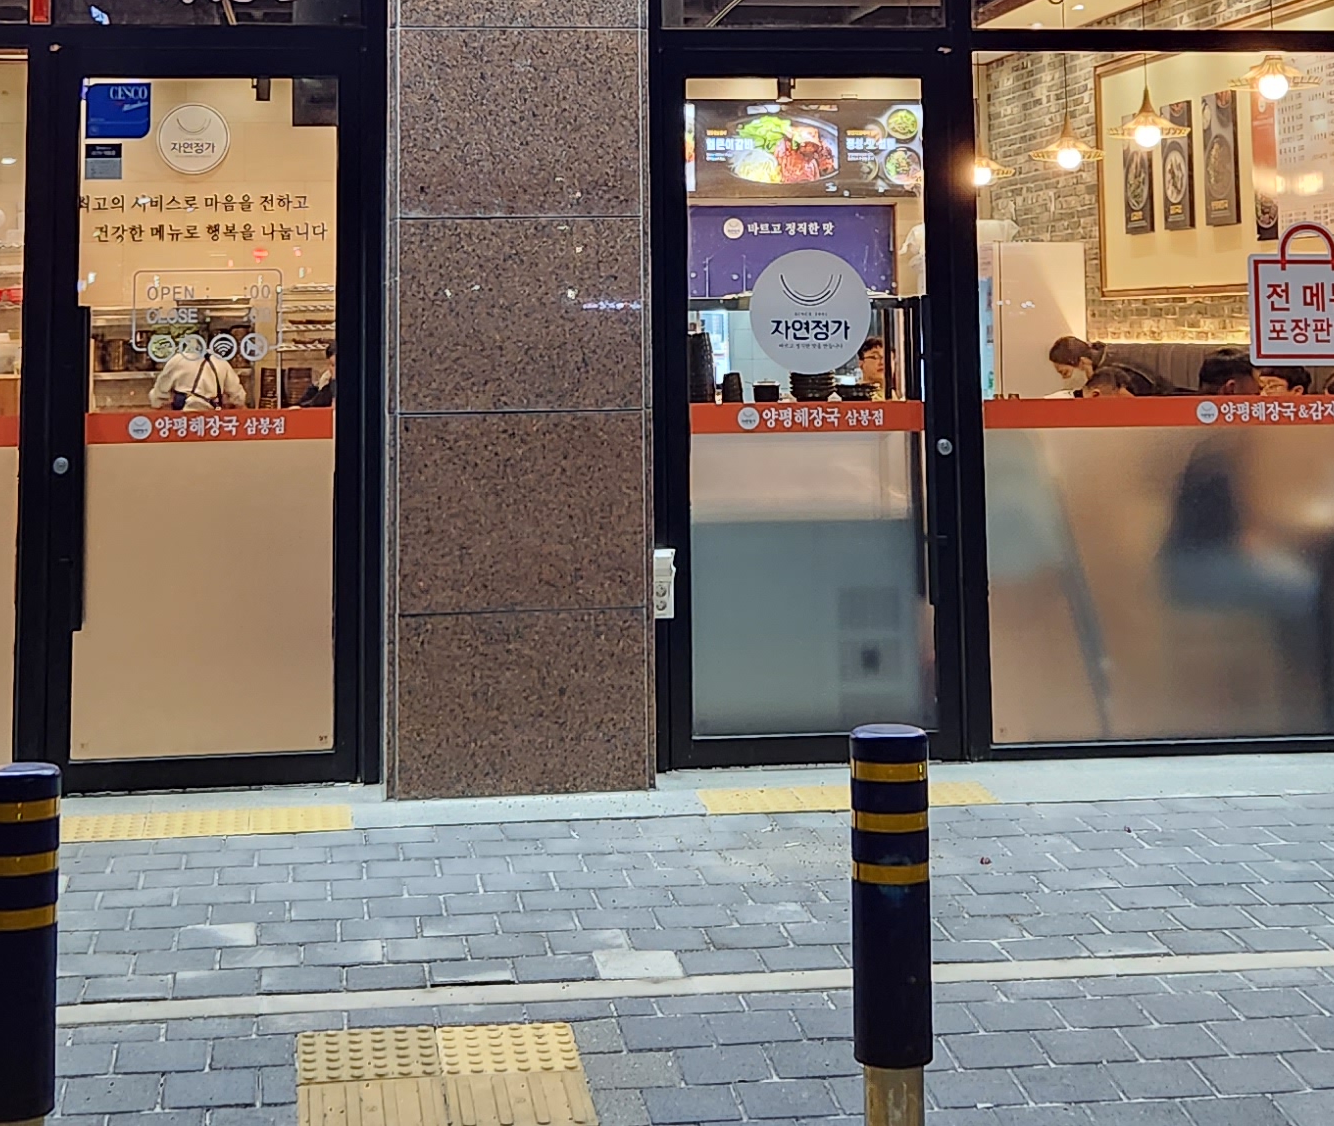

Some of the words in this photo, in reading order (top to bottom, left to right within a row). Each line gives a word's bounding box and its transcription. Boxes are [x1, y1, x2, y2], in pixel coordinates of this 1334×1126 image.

[170, 142, 216, 154] 자연정가
[204, 194, 255, 212] 마음을
[259, 193, 310, 212] 전하고
[150, 224, 201, 242] 메뉴로
[206, 224, 256, 242] 행복을
[261, 224, 328, 242] 나눕니다
[747, 222, 782, 235] 바르고
[822, 221, 835, 235] 맛
[147, 285, 195, 301] OPEN
[1266, 281, 1290, 312] 전
[146, 308, 199, 324] CLOSE
[770, 319, 851, 341] 자연정가
[762, 406, 841, 428] 양평해장국
[844, 408, 884, 426] 삼봉점
[154, 415, 240, 438] 양평해장국
[243, 417, 286, 435] 삼봉점
